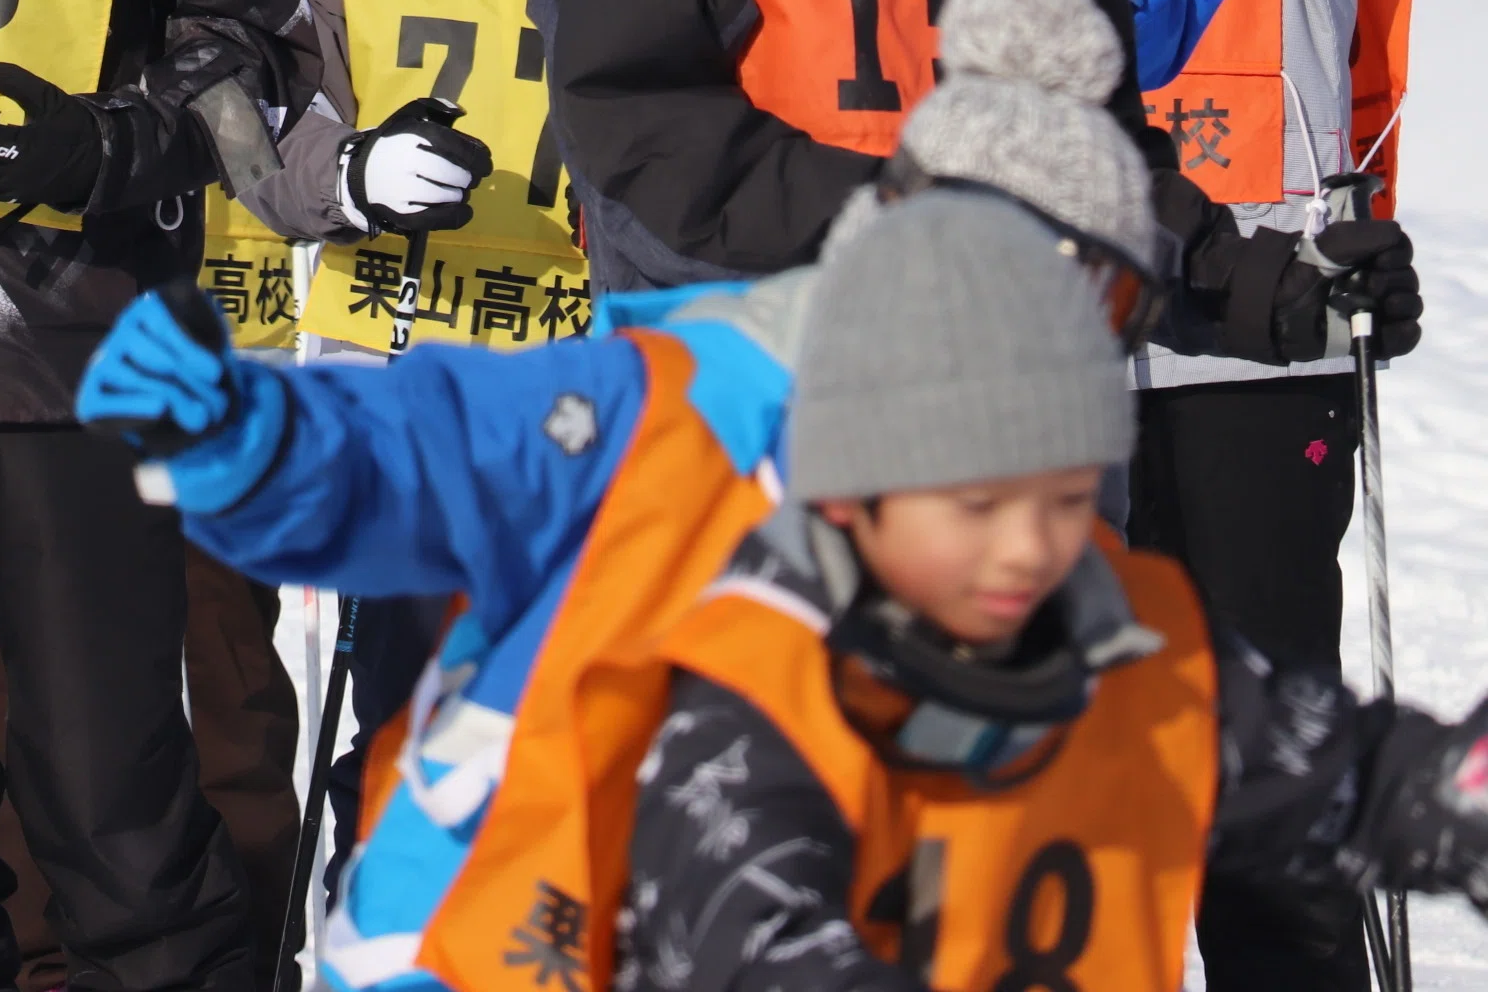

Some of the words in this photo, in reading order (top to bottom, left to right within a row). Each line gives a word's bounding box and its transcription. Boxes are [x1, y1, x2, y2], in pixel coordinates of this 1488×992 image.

[1144, 98, 1232, 170] 校
[348, 248, 592, 345] 栗山高校
